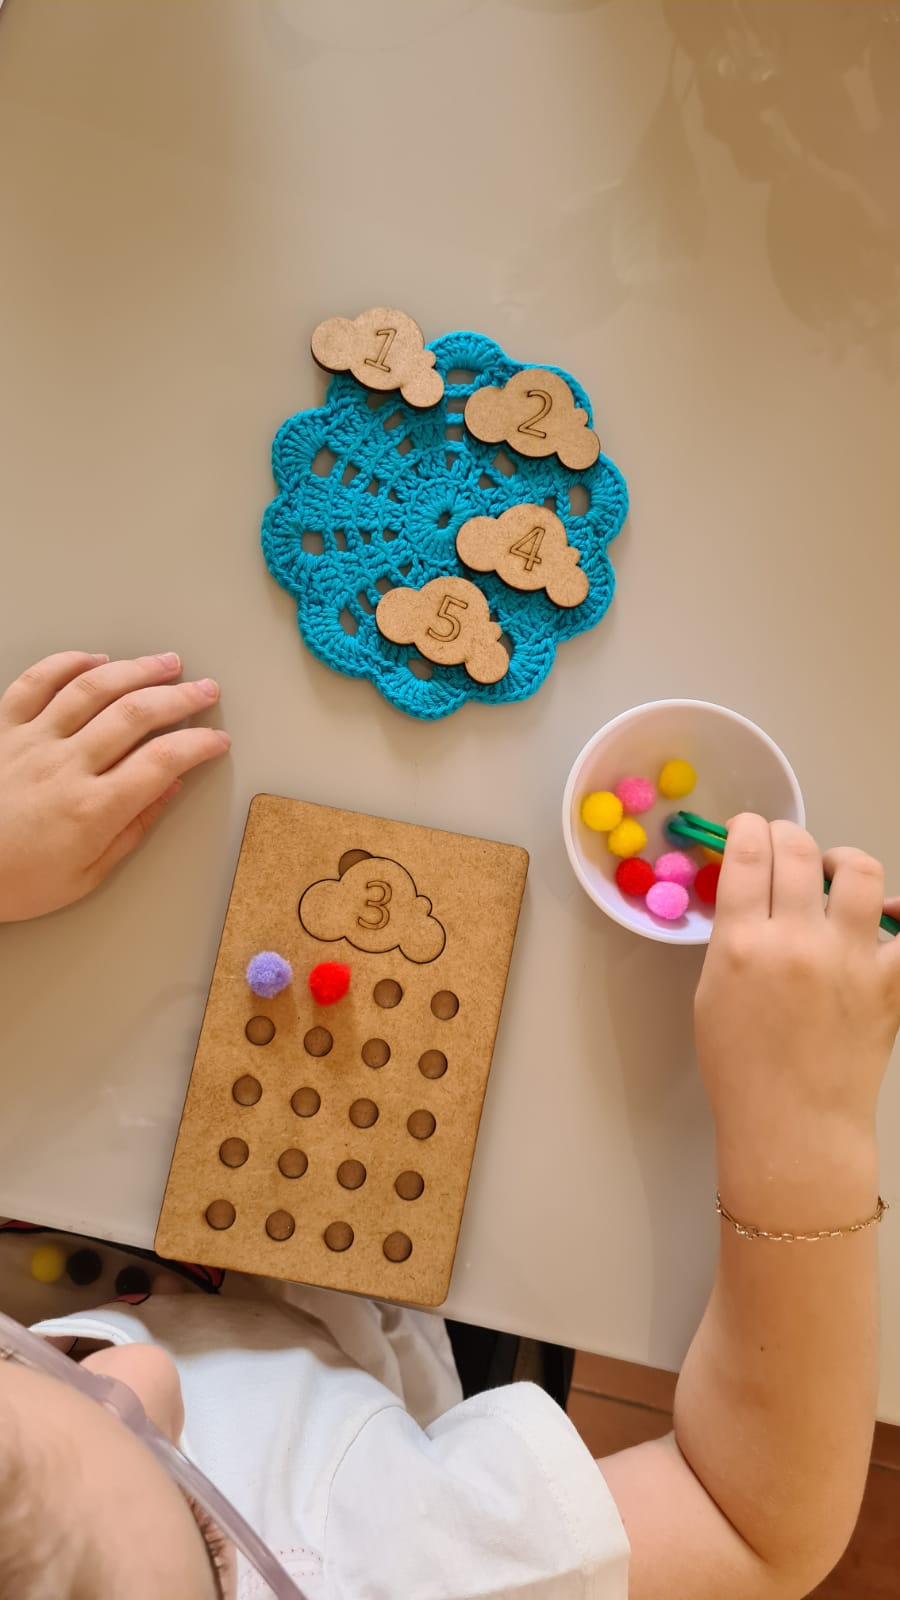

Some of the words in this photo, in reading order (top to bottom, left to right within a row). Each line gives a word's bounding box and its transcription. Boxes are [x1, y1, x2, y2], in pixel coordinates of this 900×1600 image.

[364, 328, 397, 373] 1
[517, 389, 553, 439] 2
[509, 526, 546, 572] 4
[426, 595, 469, 643] 5
[357, 880, 393, 930] 3
